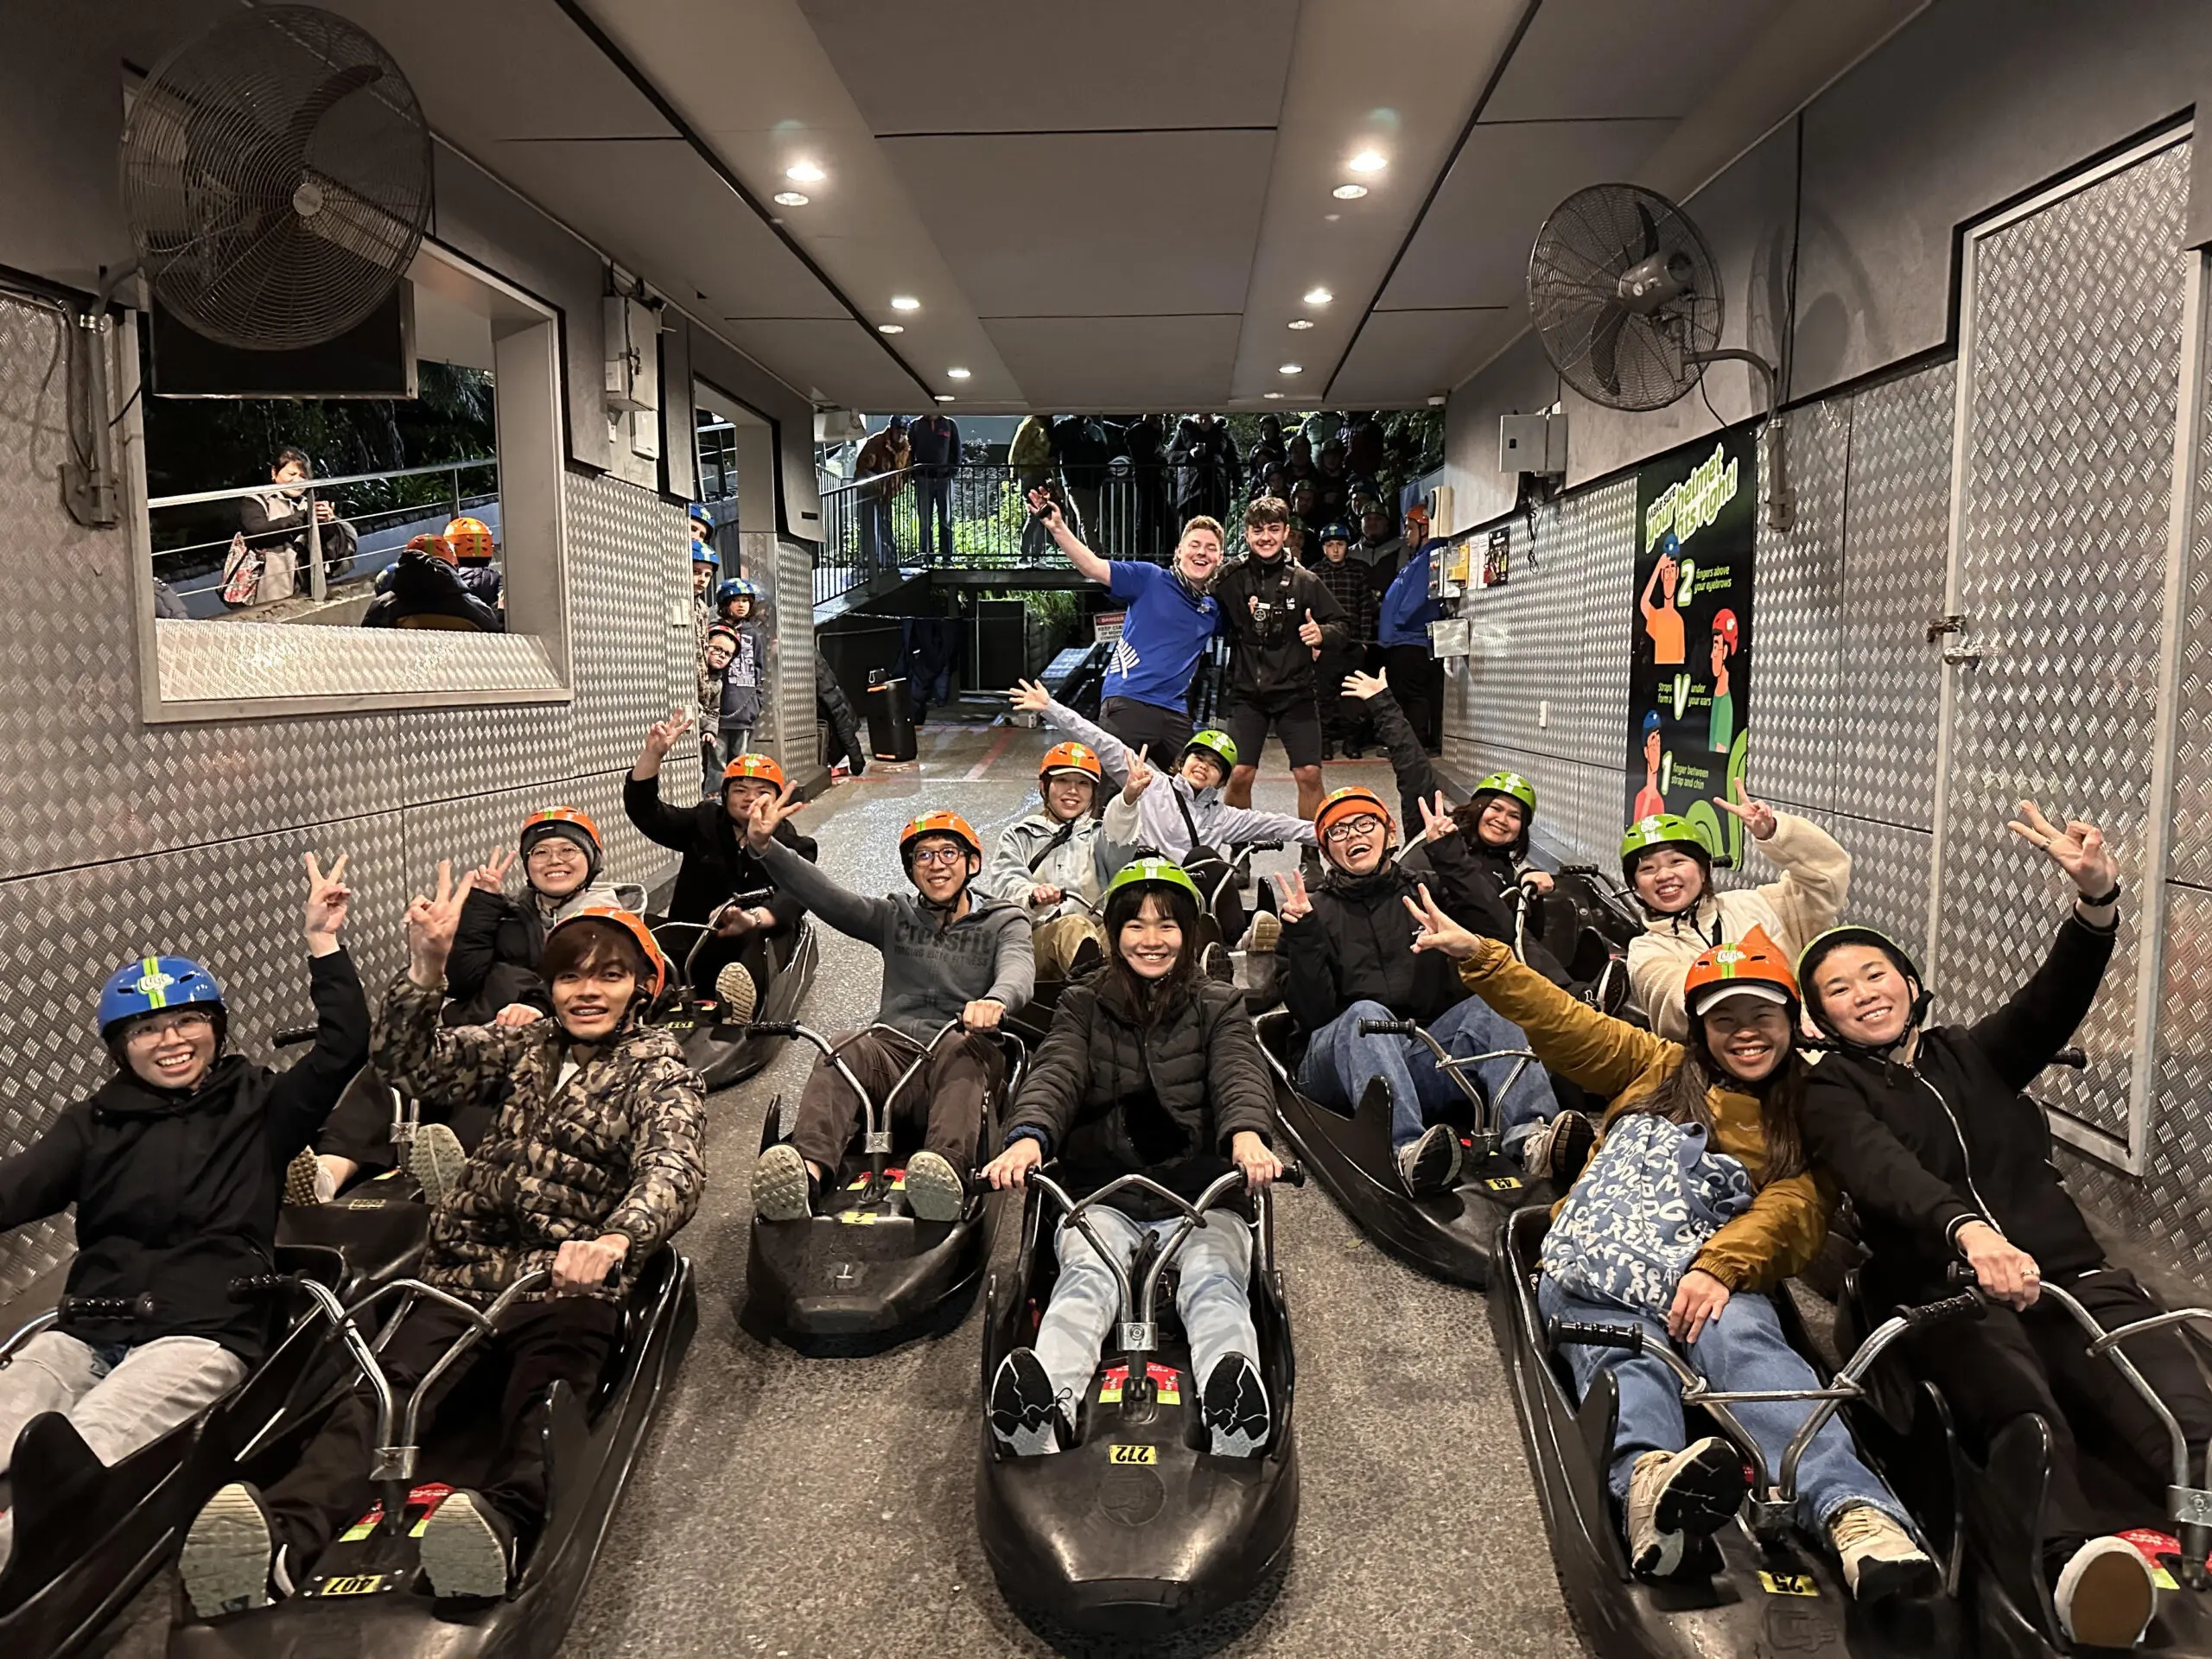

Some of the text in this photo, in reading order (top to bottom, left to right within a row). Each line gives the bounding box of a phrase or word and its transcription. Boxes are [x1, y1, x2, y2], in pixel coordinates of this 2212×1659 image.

[1646, 445, 1722, 550] your helmet
[1648, 486, 1676, 518] Make sure
[1676, 461, 1737, 542] fits right!
[1696, 566, 1730, 581] fingers above
[1677, 558, 1695, 607] 2
[1694, 578, 1732, 594] your eyebrows
[1658, 683, 1706, 693] Straps under
[1674, 673, 1691, 721] V
[1688, 697, 1700, 707] your
[1700, 697, 1712, 706] ears
[1661, 750, 1673, 796] 1
[1673, 762, 1709, 778] finger between
[1671, 775, 1704, 790] strap and chin
[1493, 1179, 1512, 1189] 43
[1116, 1446, 1149, 1462] 272
[327, 1578, 375, 1593] 407
[1771, 1573, 1803, 1592] 25
